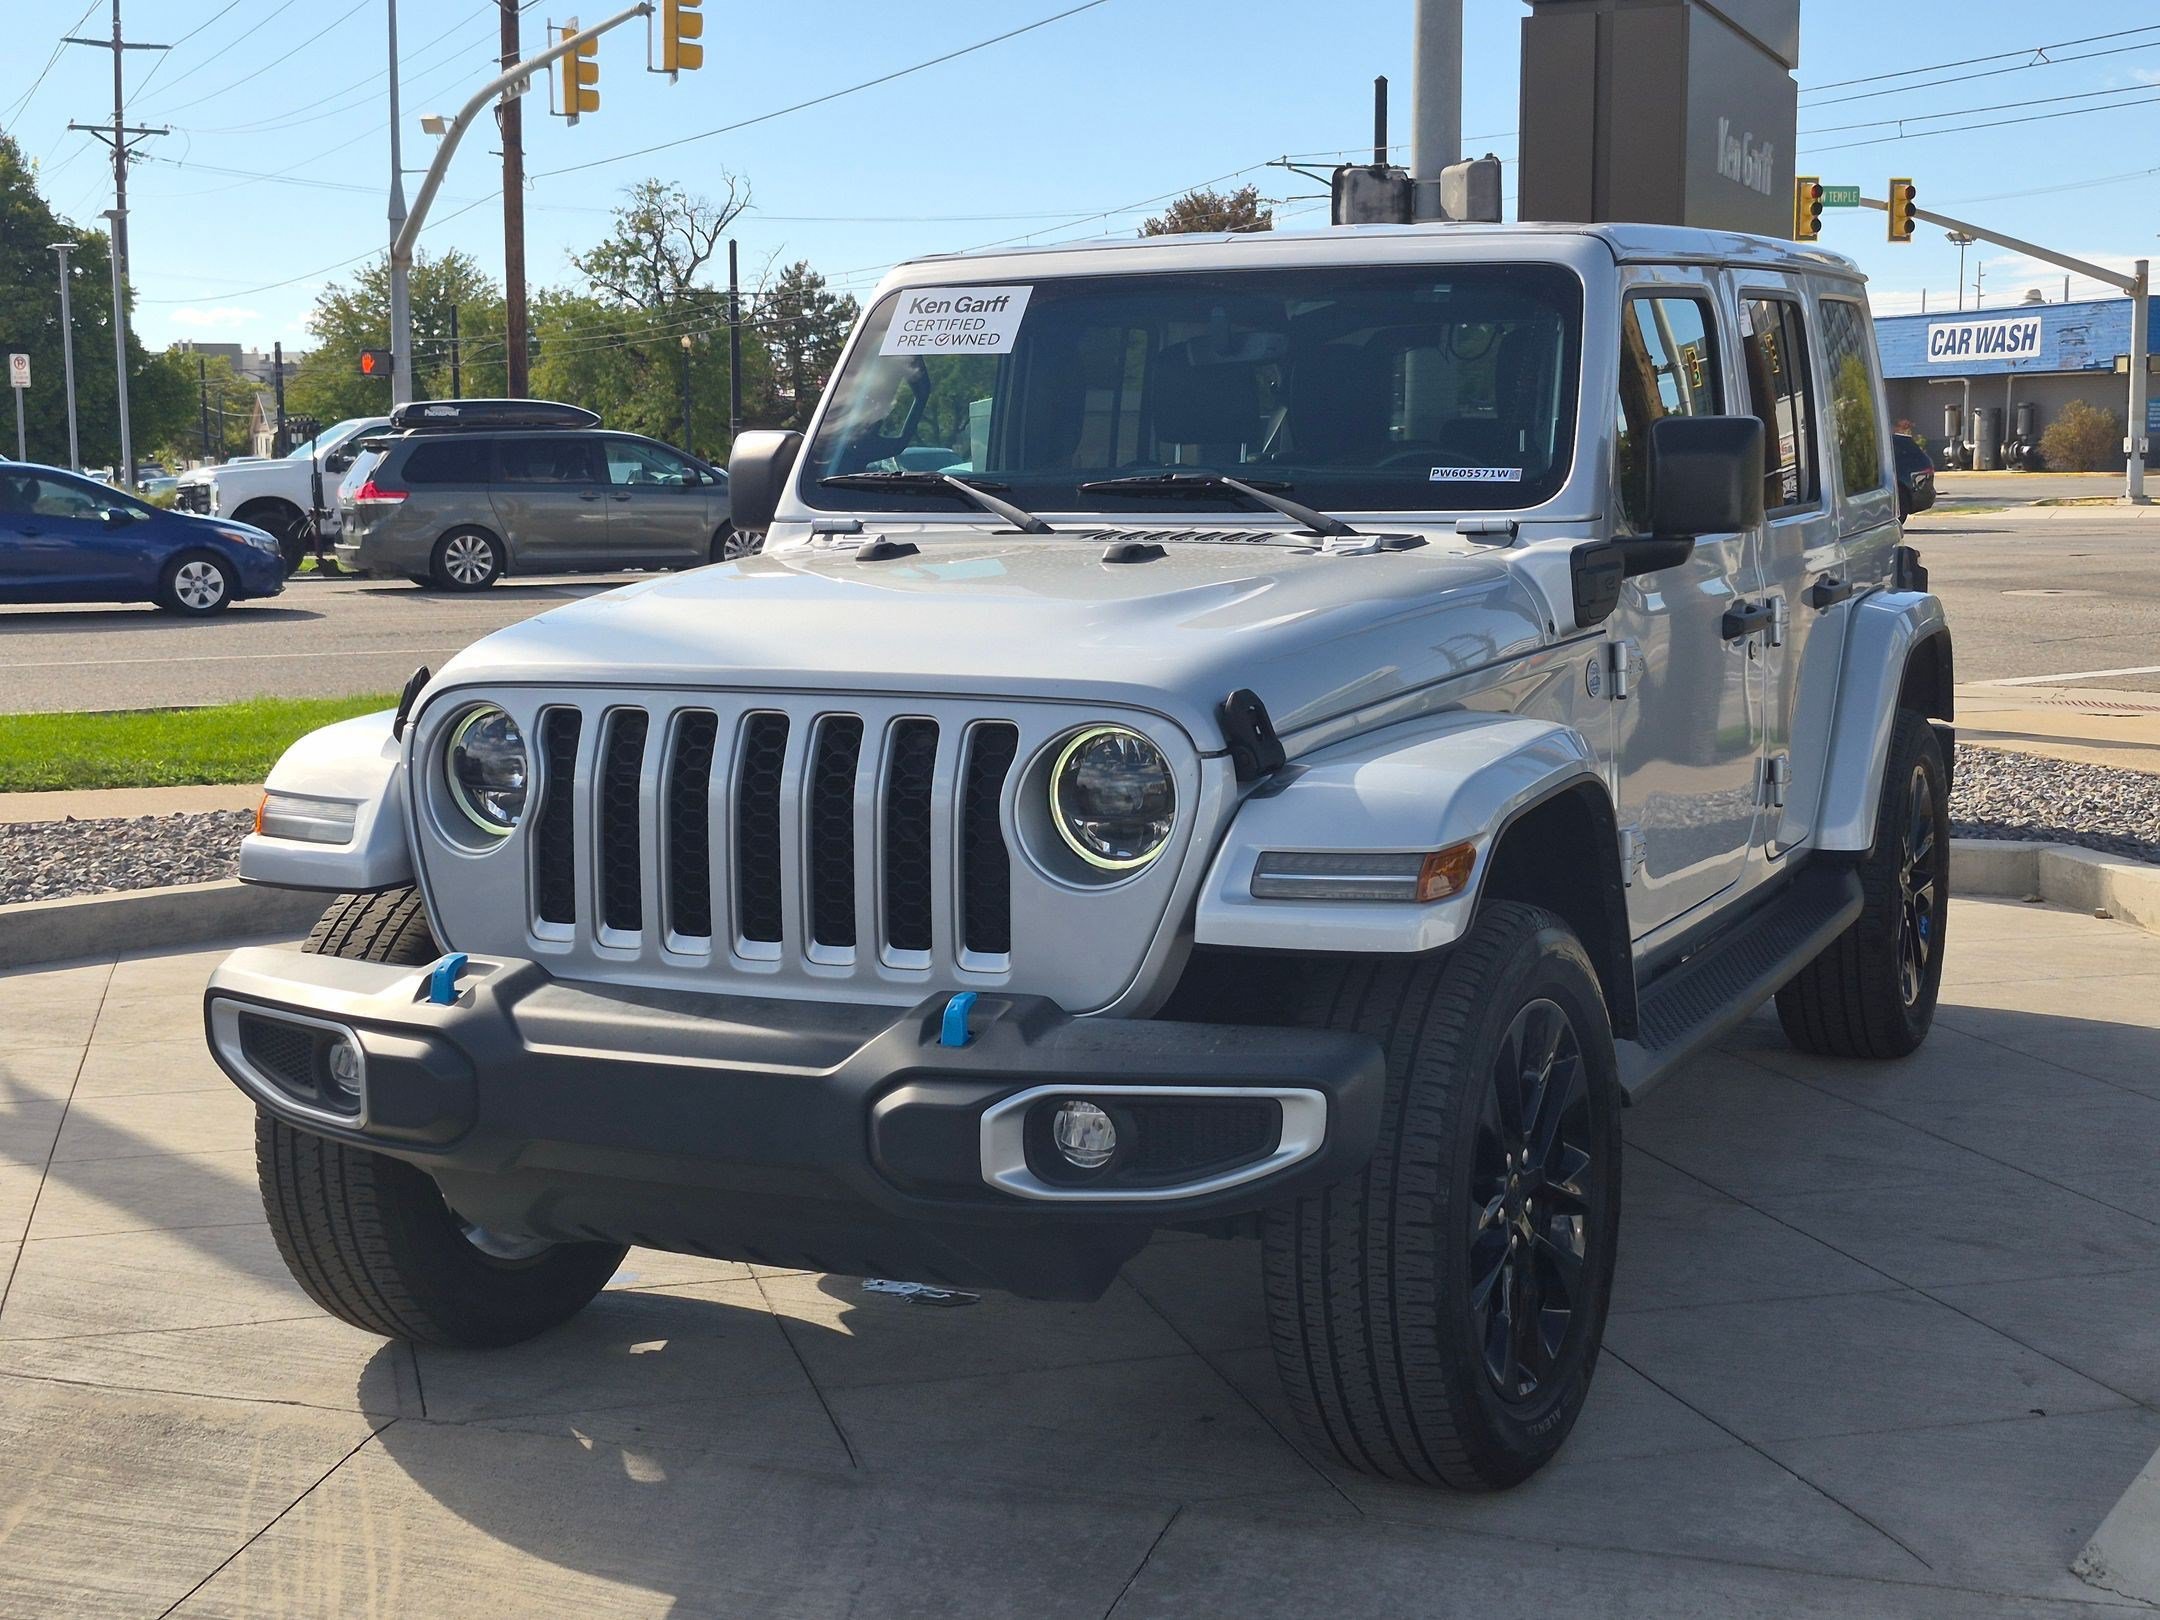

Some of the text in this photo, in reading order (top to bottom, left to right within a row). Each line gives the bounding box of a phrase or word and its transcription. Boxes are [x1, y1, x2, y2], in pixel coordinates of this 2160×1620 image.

[1717, 116, 1741, 182] Ken
[1829, 191, 1858, 203] TEMPLE
[909, 295, 1010, 315] Ken Garff
[903, 318, 986, 332] CERTIFIED
[897, 333, 1001, 347] PRE-OWNED
[1930, 323, 2038, 357] CAR WASH
[1431, 468, 1510, 478] PW605571W
